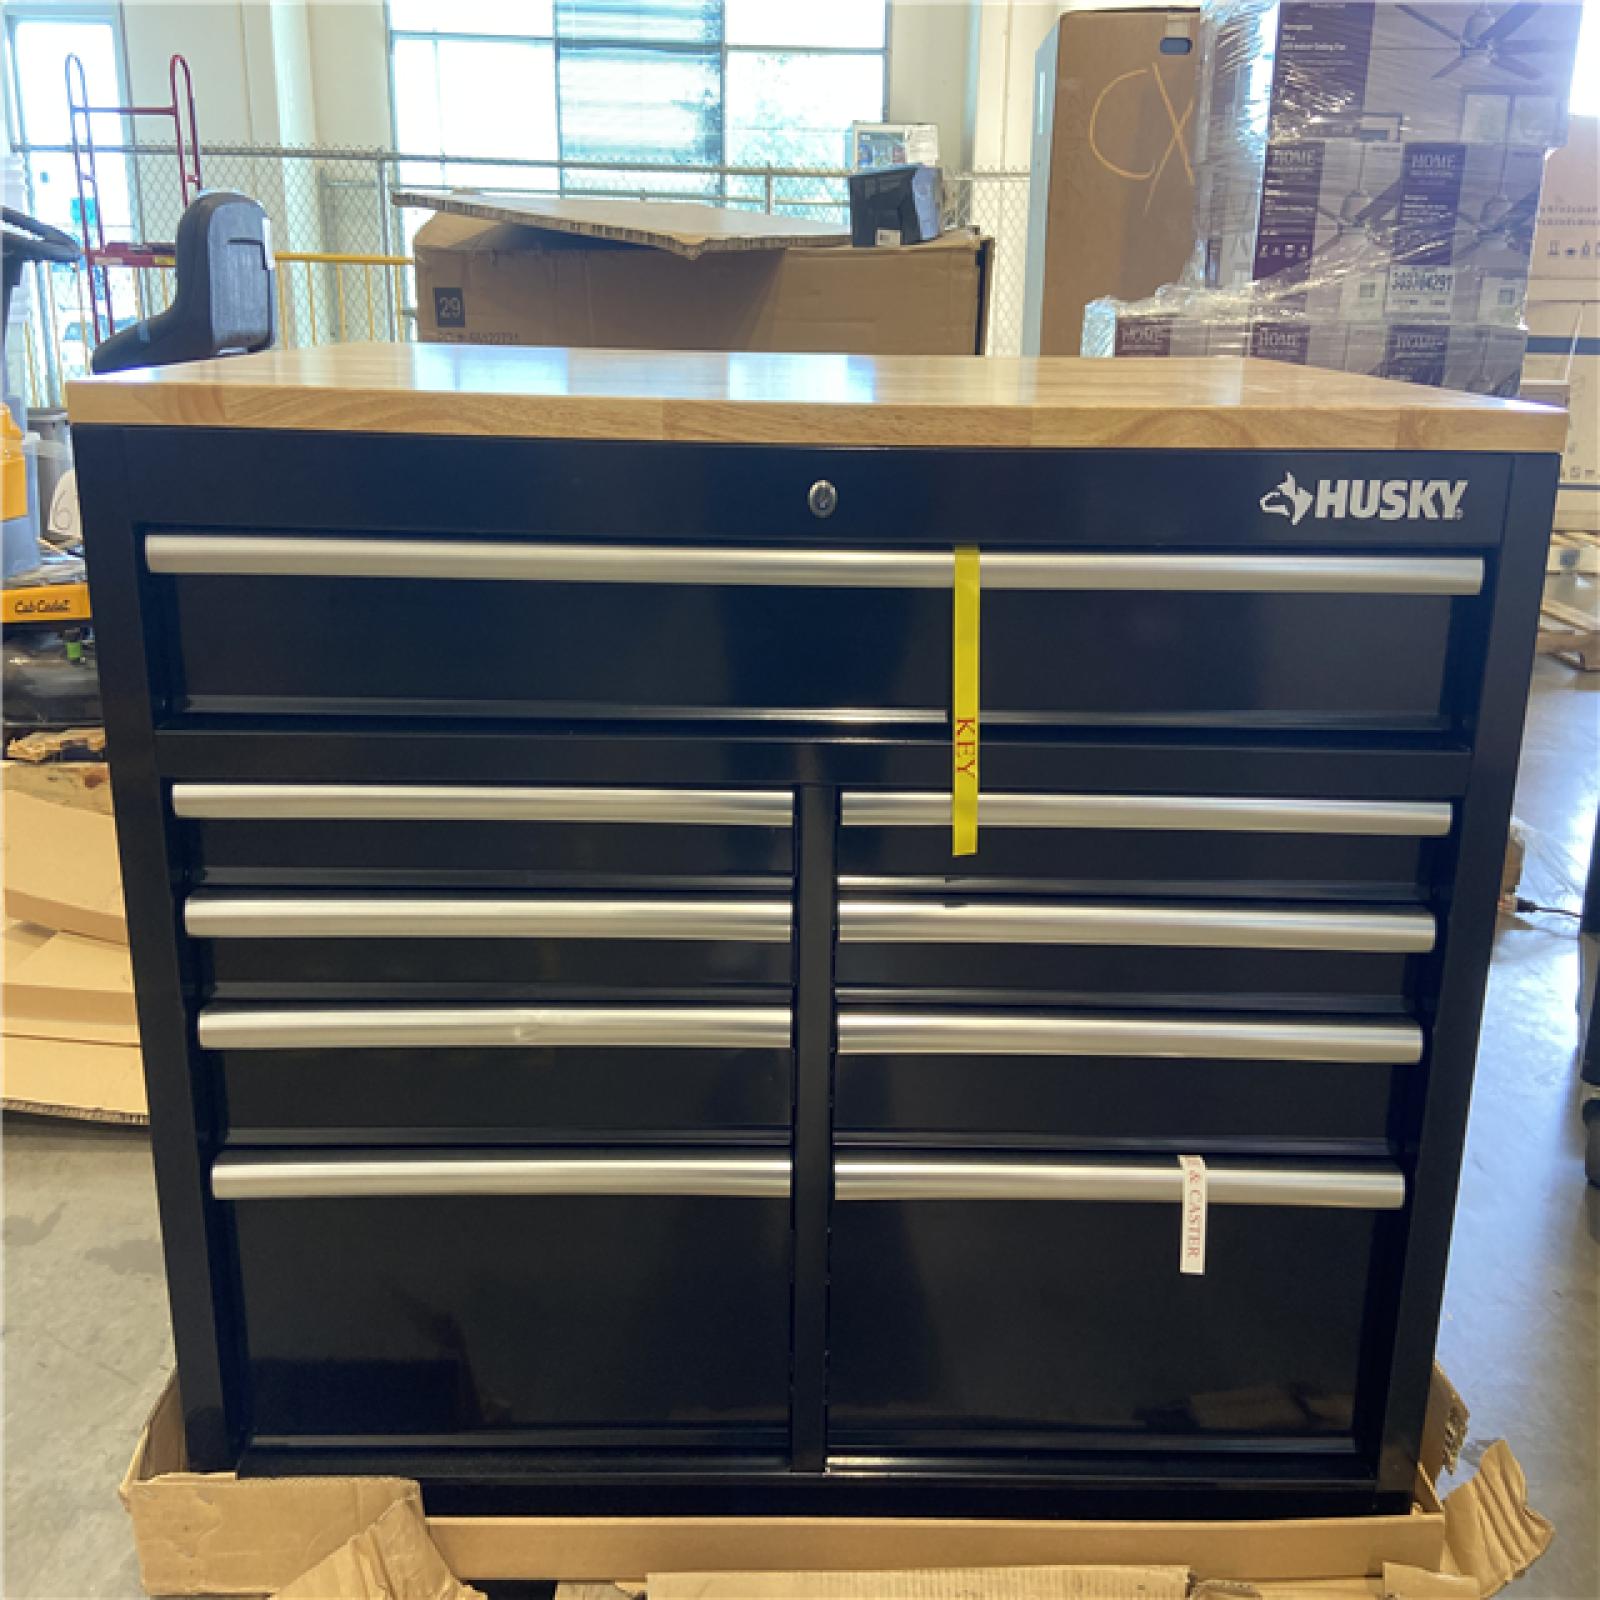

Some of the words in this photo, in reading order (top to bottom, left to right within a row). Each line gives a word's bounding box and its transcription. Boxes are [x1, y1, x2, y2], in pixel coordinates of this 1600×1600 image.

[439, 297, 461, 319] 29
[1314, 479, 1469, 520] HUSKY
[956, 719, 976, 779] KEY
[1188, 1189, 1201, 1257] CASTER
